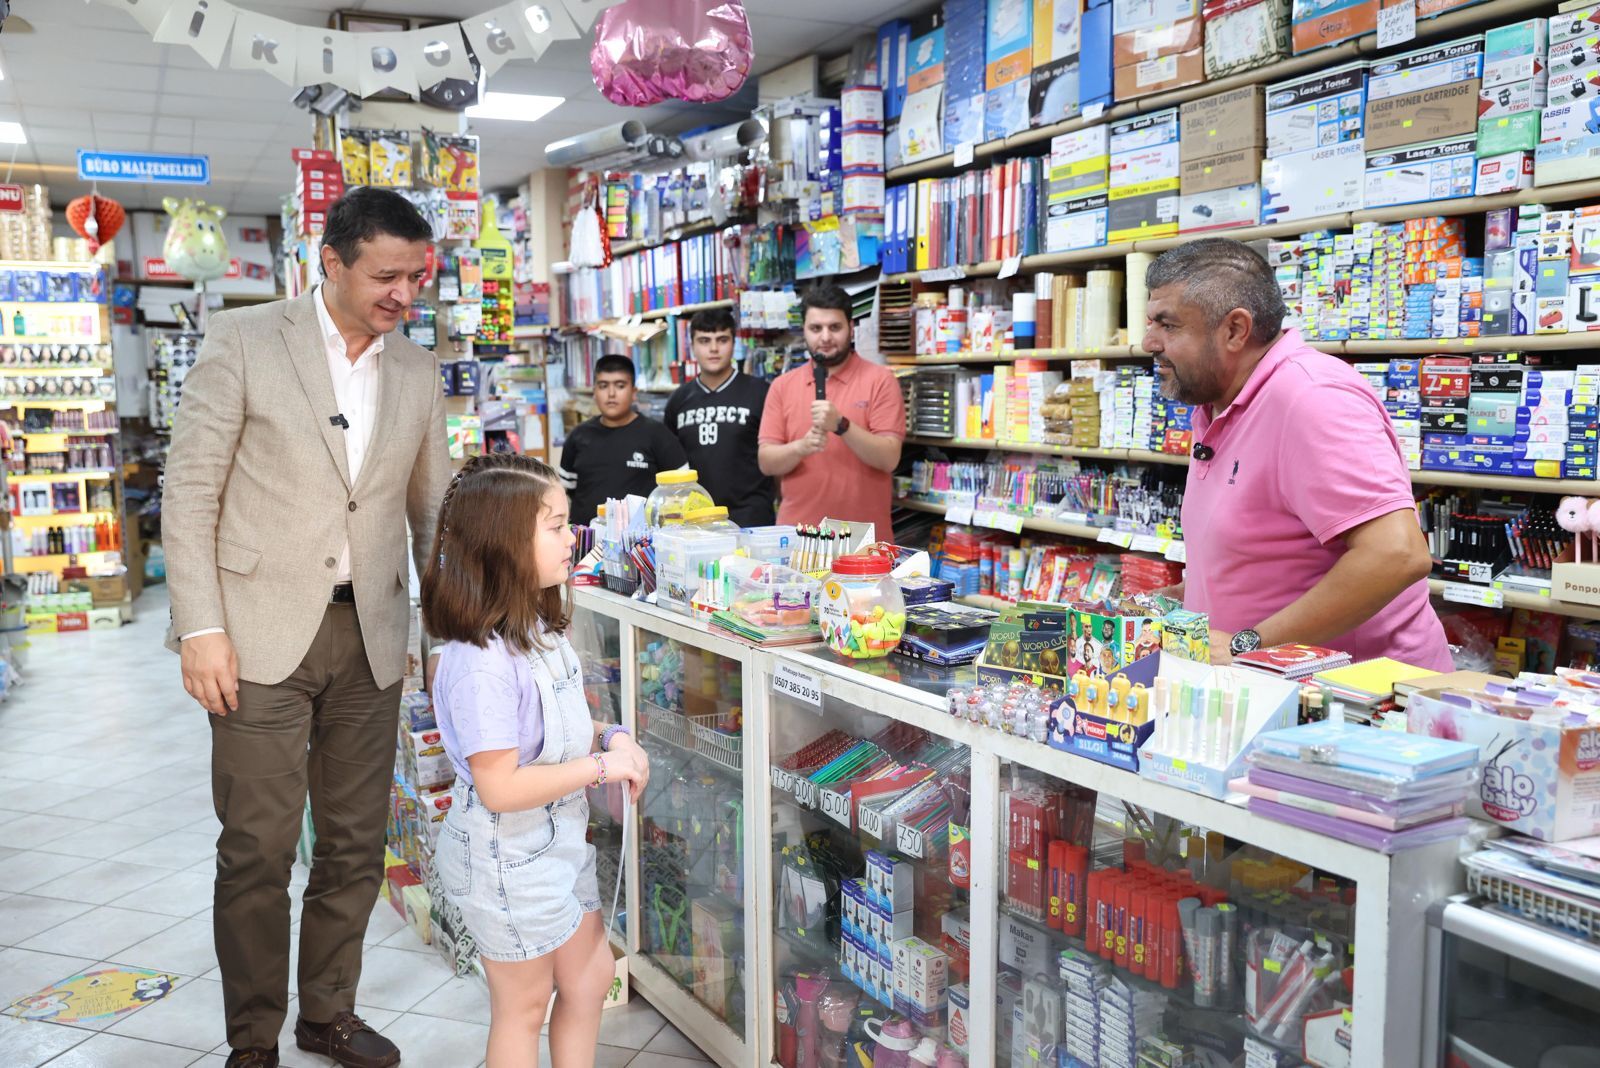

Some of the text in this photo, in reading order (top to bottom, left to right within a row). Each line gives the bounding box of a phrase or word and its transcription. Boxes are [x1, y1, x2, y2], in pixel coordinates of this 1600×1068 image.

[1408, 42, 1478, 65] Laser Toner
[1219, 87, 1252, 106] CARTRIDGE
[1300, 77, 1351, 97] Laser Toner
[1371, 84, 1470, 114] LASER TONER CARTRIDGE
[1133, 117, 1152, 130] Laser
[1153, 112, 1173, 125] Toner
[1312, 143, 1361, 161] LASER TONER
[1406, 142, 1471, 159] Laser Toner
[86, 157, 203, 178] BÜRO MALZEMELERİ
[1185, 152, 1244, 172] LASER TONER CARTRIDGE
[1069, 197, 1107, 210] Laser Toner
[677, 406, 750, 430] RESPECT
[699, 422, 718, 445] 89
[1470, 566, 1488, 578] 0.7
[1565, 581, 1600, 594] Ponpo
[990, 631, 1016, 641] WORLD
[1021, 640, 1050, 651] WORLD
[774, 676, 819, 701] 0507 385 20 95
[980, 673, 1002, 684] WORLD
[1483, 765, 1535, 798] alo
[821, 791, 849, 817] 15.00
[1480, 782, 1538, 817] baby
[898, 823, 922, 854] 7.50
[1009, 923, 1034, 942] Makas
